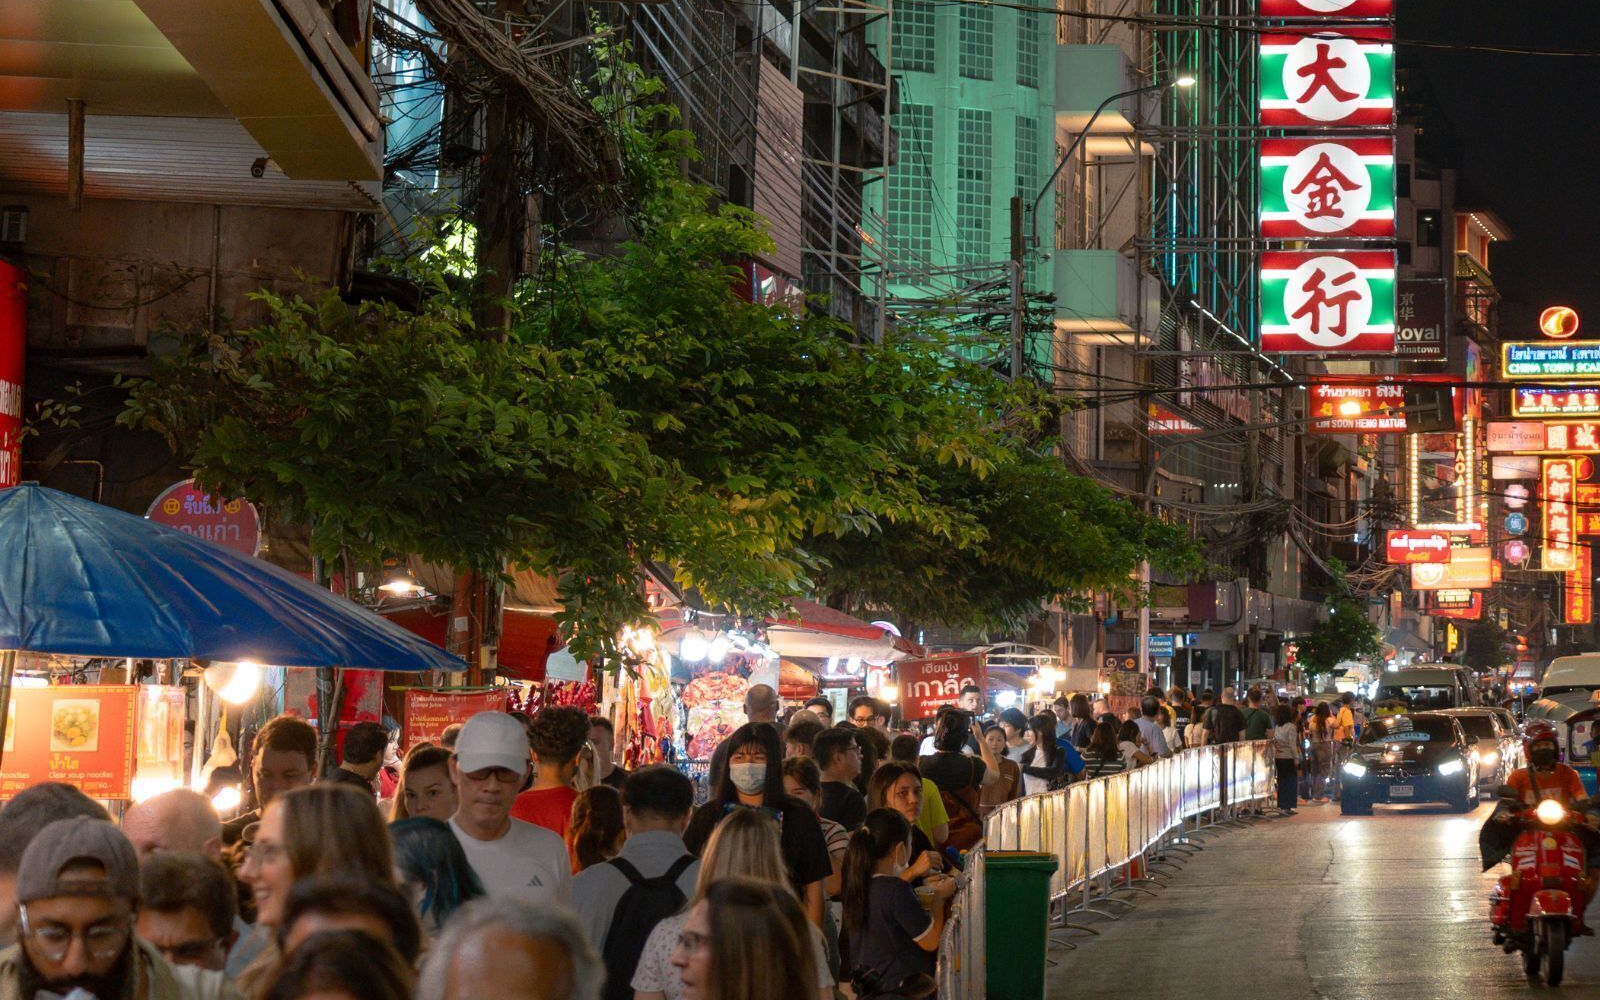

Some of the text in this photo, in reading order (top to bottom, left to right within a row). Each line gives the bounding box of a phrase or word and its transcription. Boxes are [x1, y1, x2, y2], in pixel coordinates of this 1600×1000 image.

[1508, 362, 1541, 374] CHINA
[1542, 362, 1574, 374] TOWN
[1332, 418, 1356, 429] SOON
[1356, 418, 1378, 429] HENG
[48, 771, 67, 779] Clear
[86, 771, 114, 779] noodles
